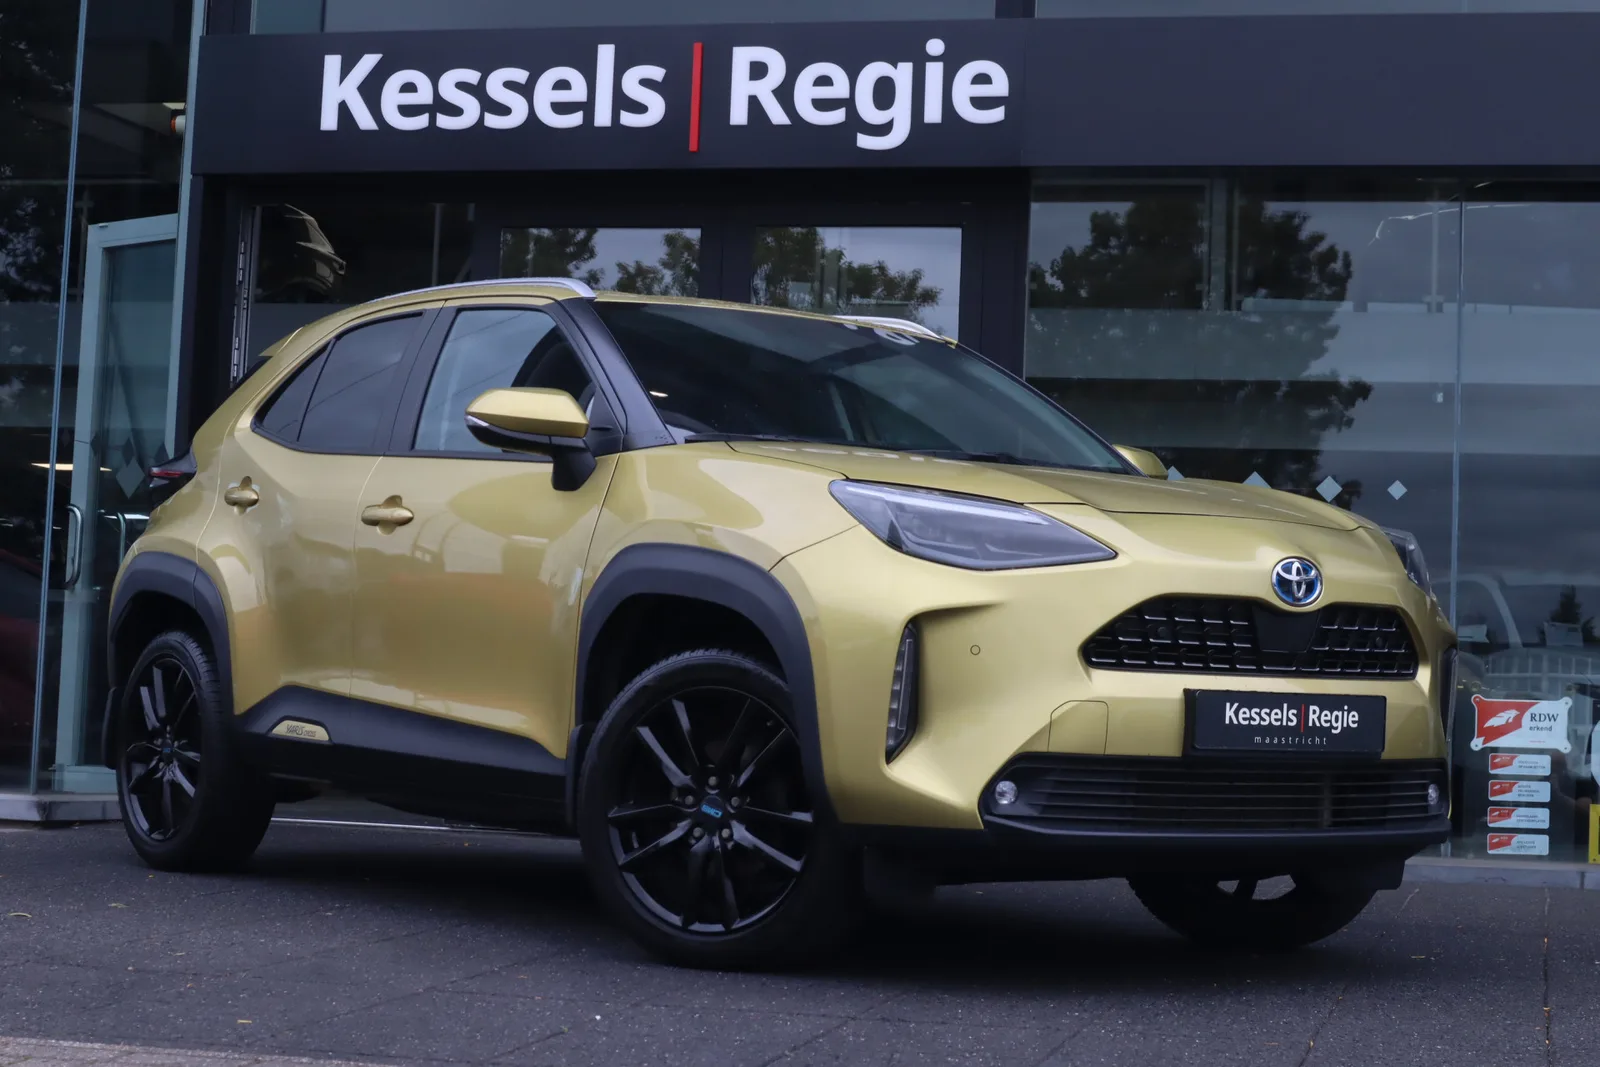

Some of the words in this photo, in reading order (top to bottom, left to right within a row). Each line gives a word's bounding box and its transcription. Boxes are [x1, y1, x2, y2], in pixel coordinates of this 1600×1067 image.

[321, 44, 666, 130] Kessels
[730, 39, 1009, 150] Regie
[1226, 703, 1297, 726] Kessels
[1309, 705, 1358, 733] Regie
[1530, 712, 1559, 723] RDW
[1254, 735, 1327, 745] maastricht
